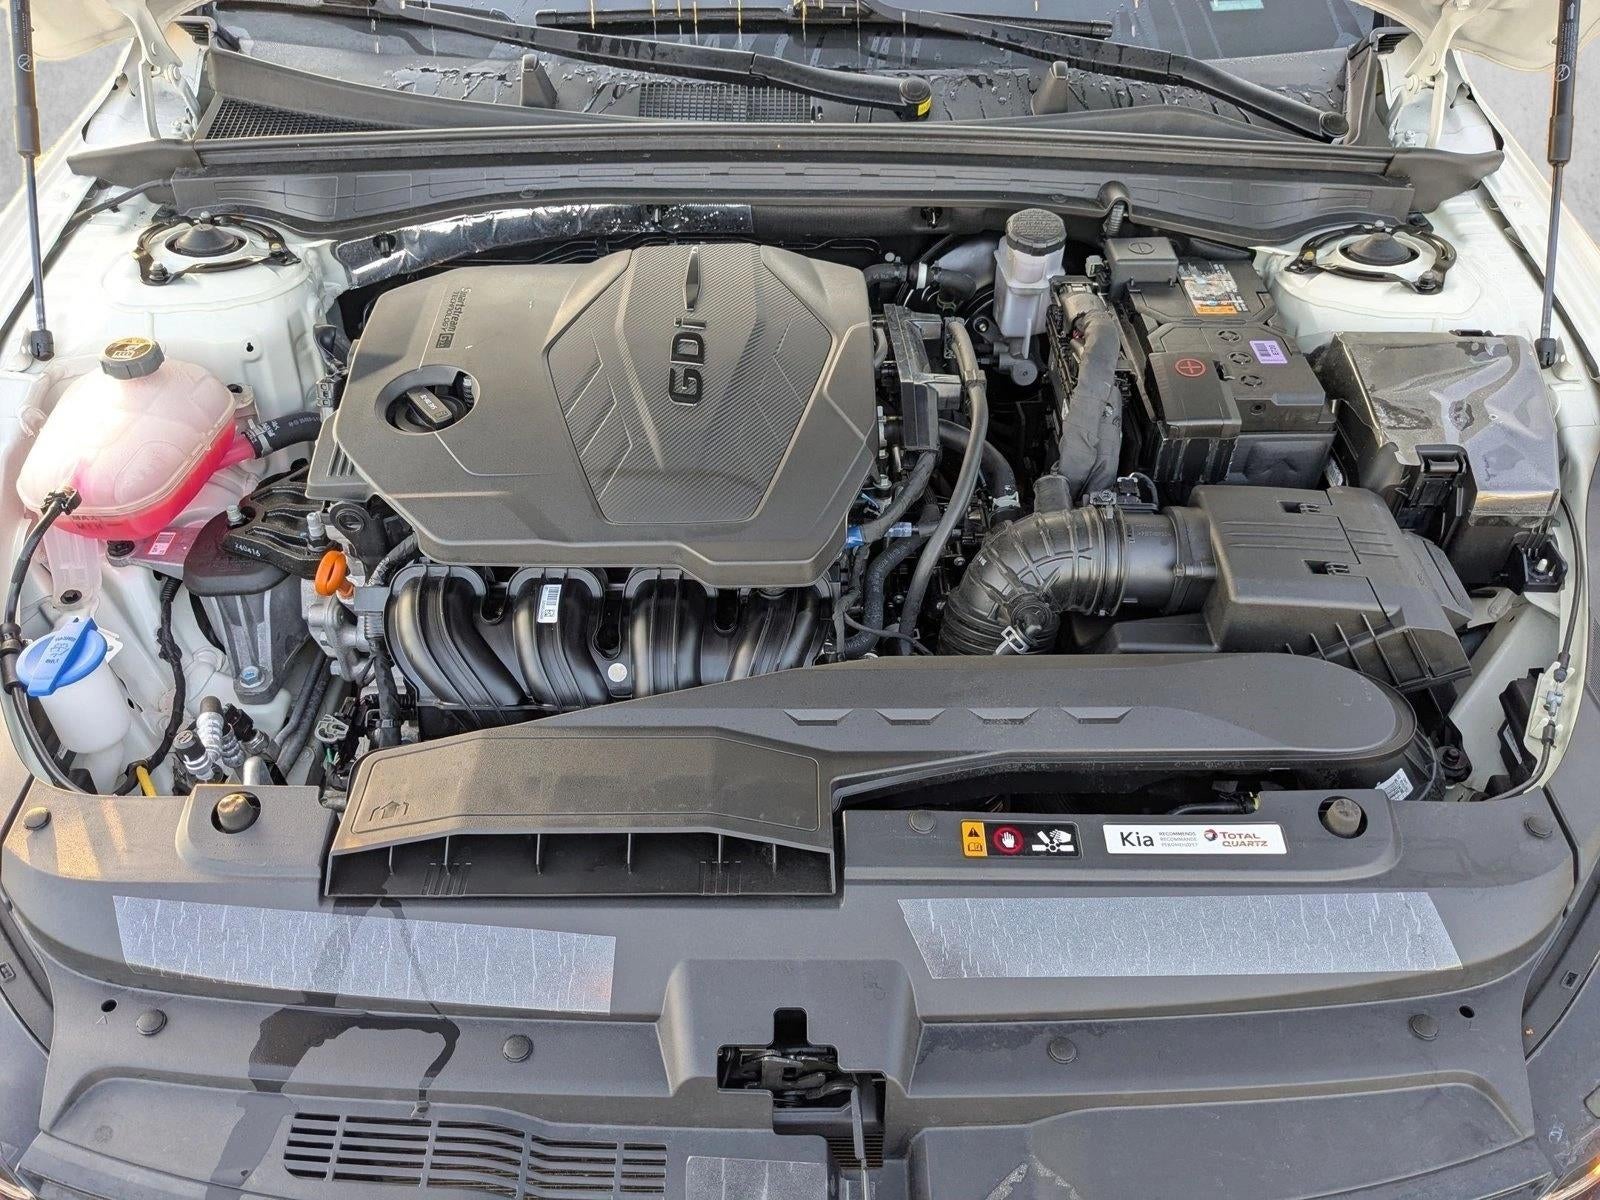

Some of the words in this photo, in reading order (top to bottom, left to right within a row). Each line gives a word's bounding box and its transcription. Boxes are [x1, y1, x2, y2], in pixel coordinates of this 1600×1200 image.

[448, 287, 471, 332] Smartstream
[1119, 831, 1155, 847] Kia
[1222, 840, 1269, 848] QUARTZ
